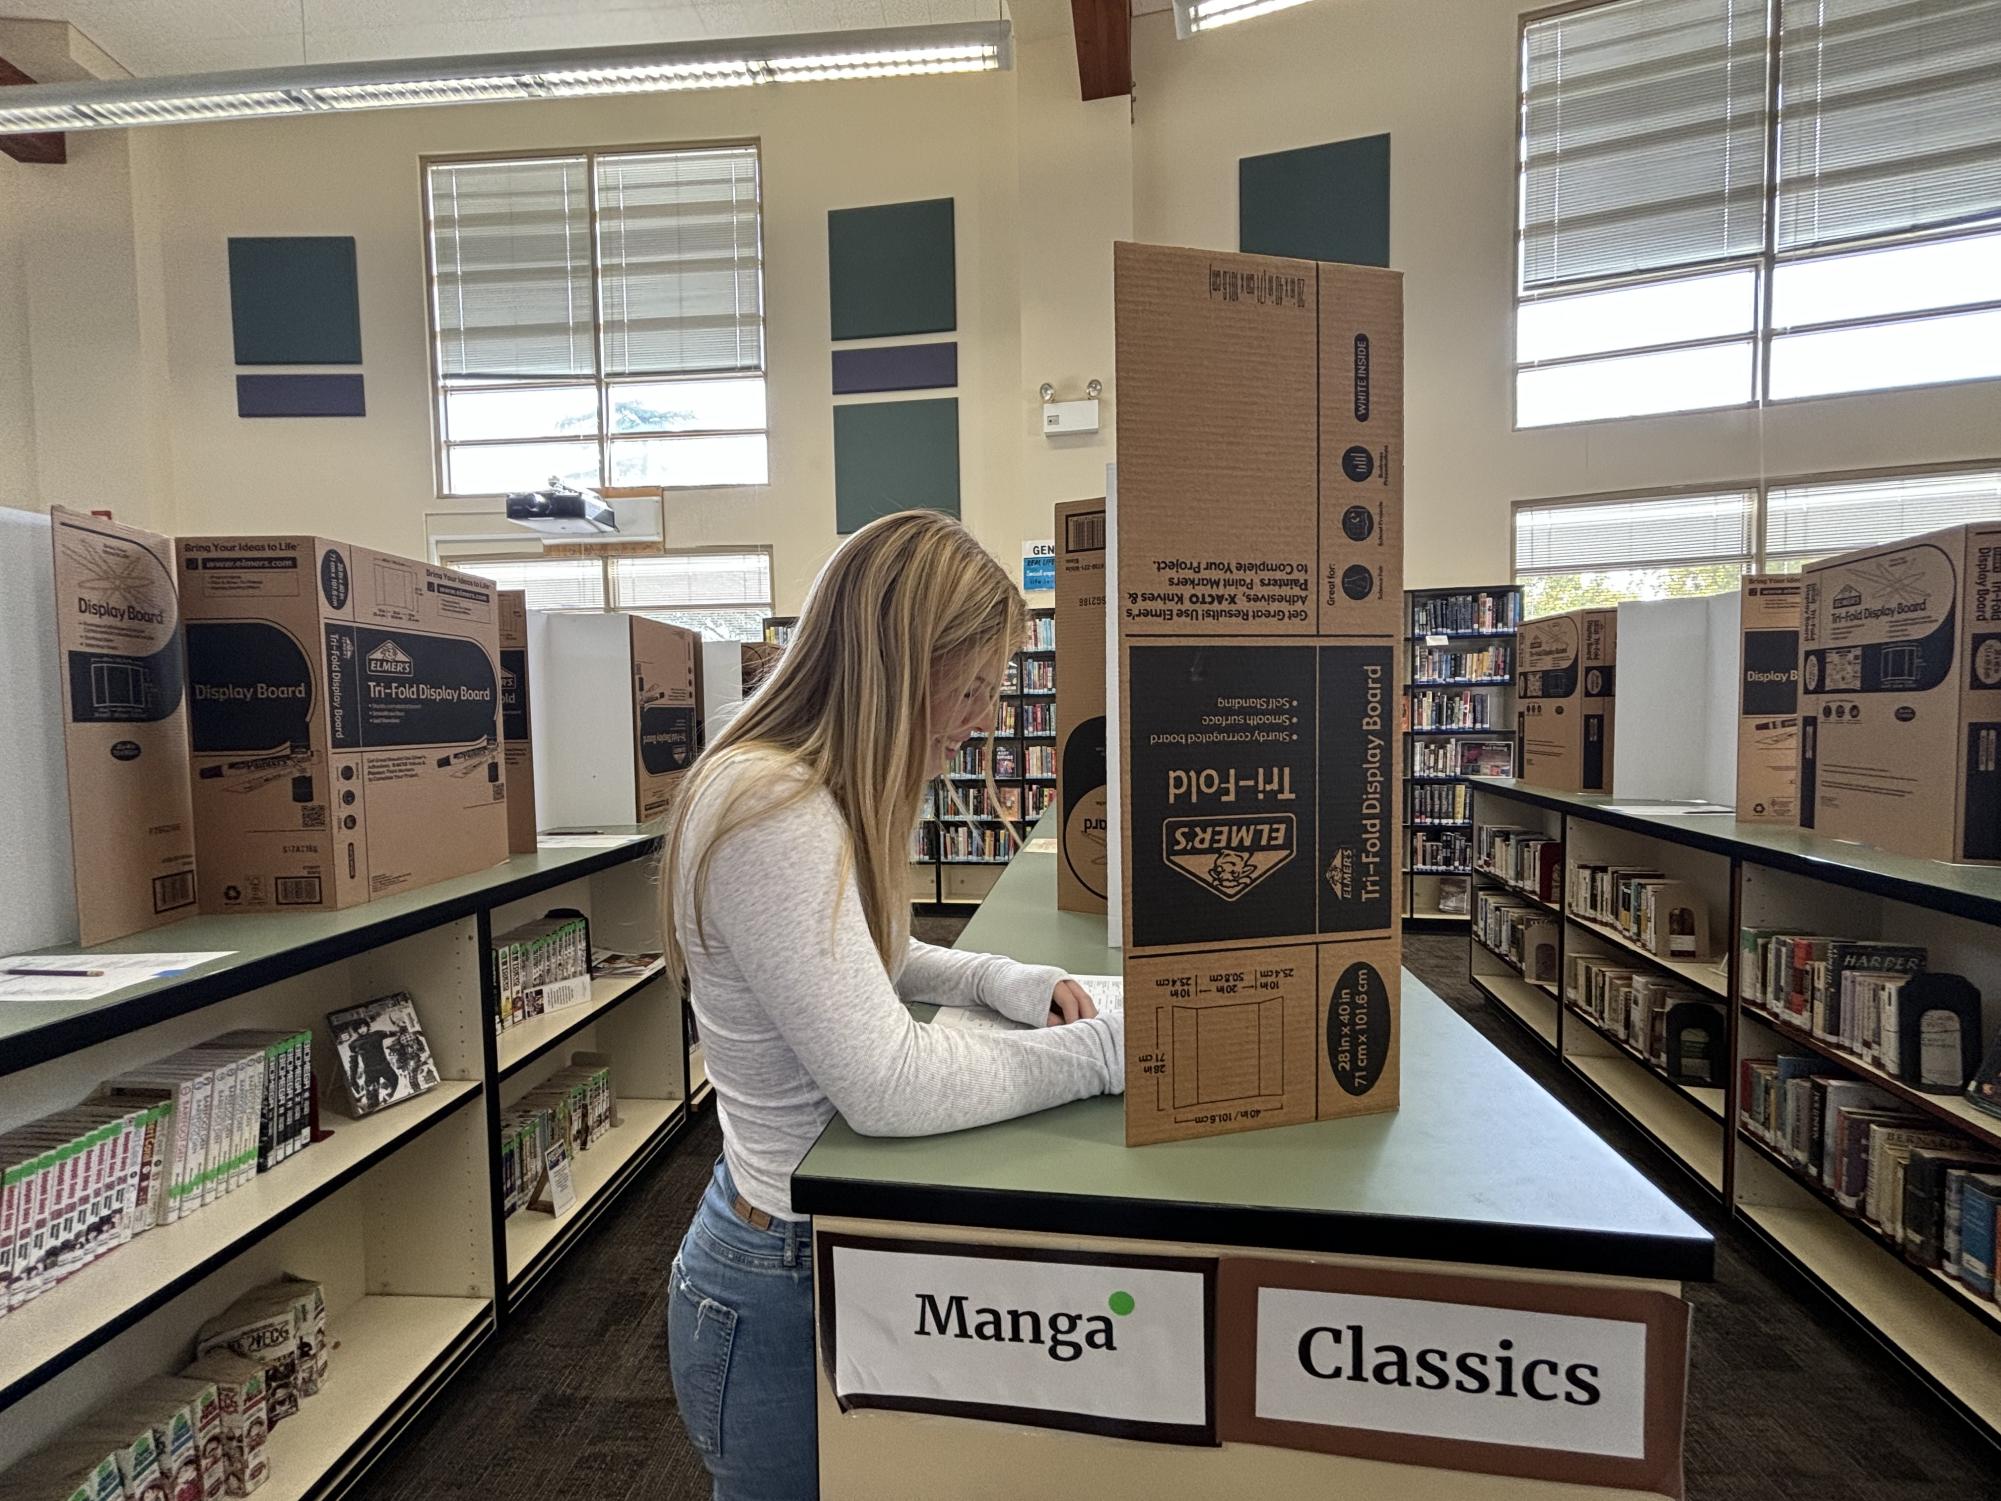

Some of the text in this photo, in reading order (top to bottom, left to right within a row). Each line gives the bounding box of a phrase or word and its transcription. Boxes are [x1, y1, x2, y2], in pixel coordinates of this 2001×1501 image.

[1358, 340, 1367, 415] WHITE INSIDE
[184, 543, 211, 553] Bring
[213, 543, 237, 552] Your
[239, 543, 266, 552] Ideas
[268, 543, 277, 551] to
[1153, 560, 1308, 574] to Complete Your Project.
[1975, 547, 1991, 587] Display
[1168, 577, 1308, 591] Painters Paint Markers
[1128, 593, 1138, 604] &
[1141, 593, 1183, 605] Knives
[1242, 592, 1308, 605] Adhesives,
[1327, 583, 1335, 606] Great
[78, 597, 164, 625] Display Board
[1126, 608, 1307, 621] Get Great Results! Use Elmer's
[1831, 607, 1862, 624] Tri-Fold
[1864, 605, 1896, 620] Display
[370, 661, 410, 673] ELMER'S
[1747, 671, 1788, 683] Display
[194, 683, 306, 701] Display Board
[329, 634, 344, 738] Tri-Fold Display Board
[368, 682, 490, 702] Tri-Fold Display Board
[1218, 697, 1289, 709] Self Standing
[1202, 714, 1289, 726] Smooth surface
[1150, 731, 1289, 745] Sturdy corrugated board
[1168, 767, 1296, 804] Tri-Fold
[1361, 665, 1384, 902] Tri-Fold Display Board
[1174, 823, 1287, 850] ELMER'S
[1342, 849, 1352, 899] ELMER'S
[1843, 954, 1919, 970] HARPER
[1224, 972, 1244, 982] 50.8
[1274, 968, 1294, 977] 25.4
[1156, 977, 1192, 987] 25.4 cm
[1260, 981, 1279, 990] 10 in
[1179, 989, 1190, 998] 10
[1216, 984, 1238, 994] 20 in
[1338, 989, 1350, 1072] 28 in x 40 in
[1355, 969, 1367, 1087] 71 cm x 101.6 cm
[1155, 1053, 1165, 1062] 71
[1143, 1064, 1166, 1073] 28 in
[1210, 1113, 1232, 1122] 101.6
[1241, 1110, 1249, 1118] in
[1250, 1109, 1261, 1118] 40
[914, 1291, 1117, 1363] Manga
[1297, 1323, 1601, 1407] Classics
